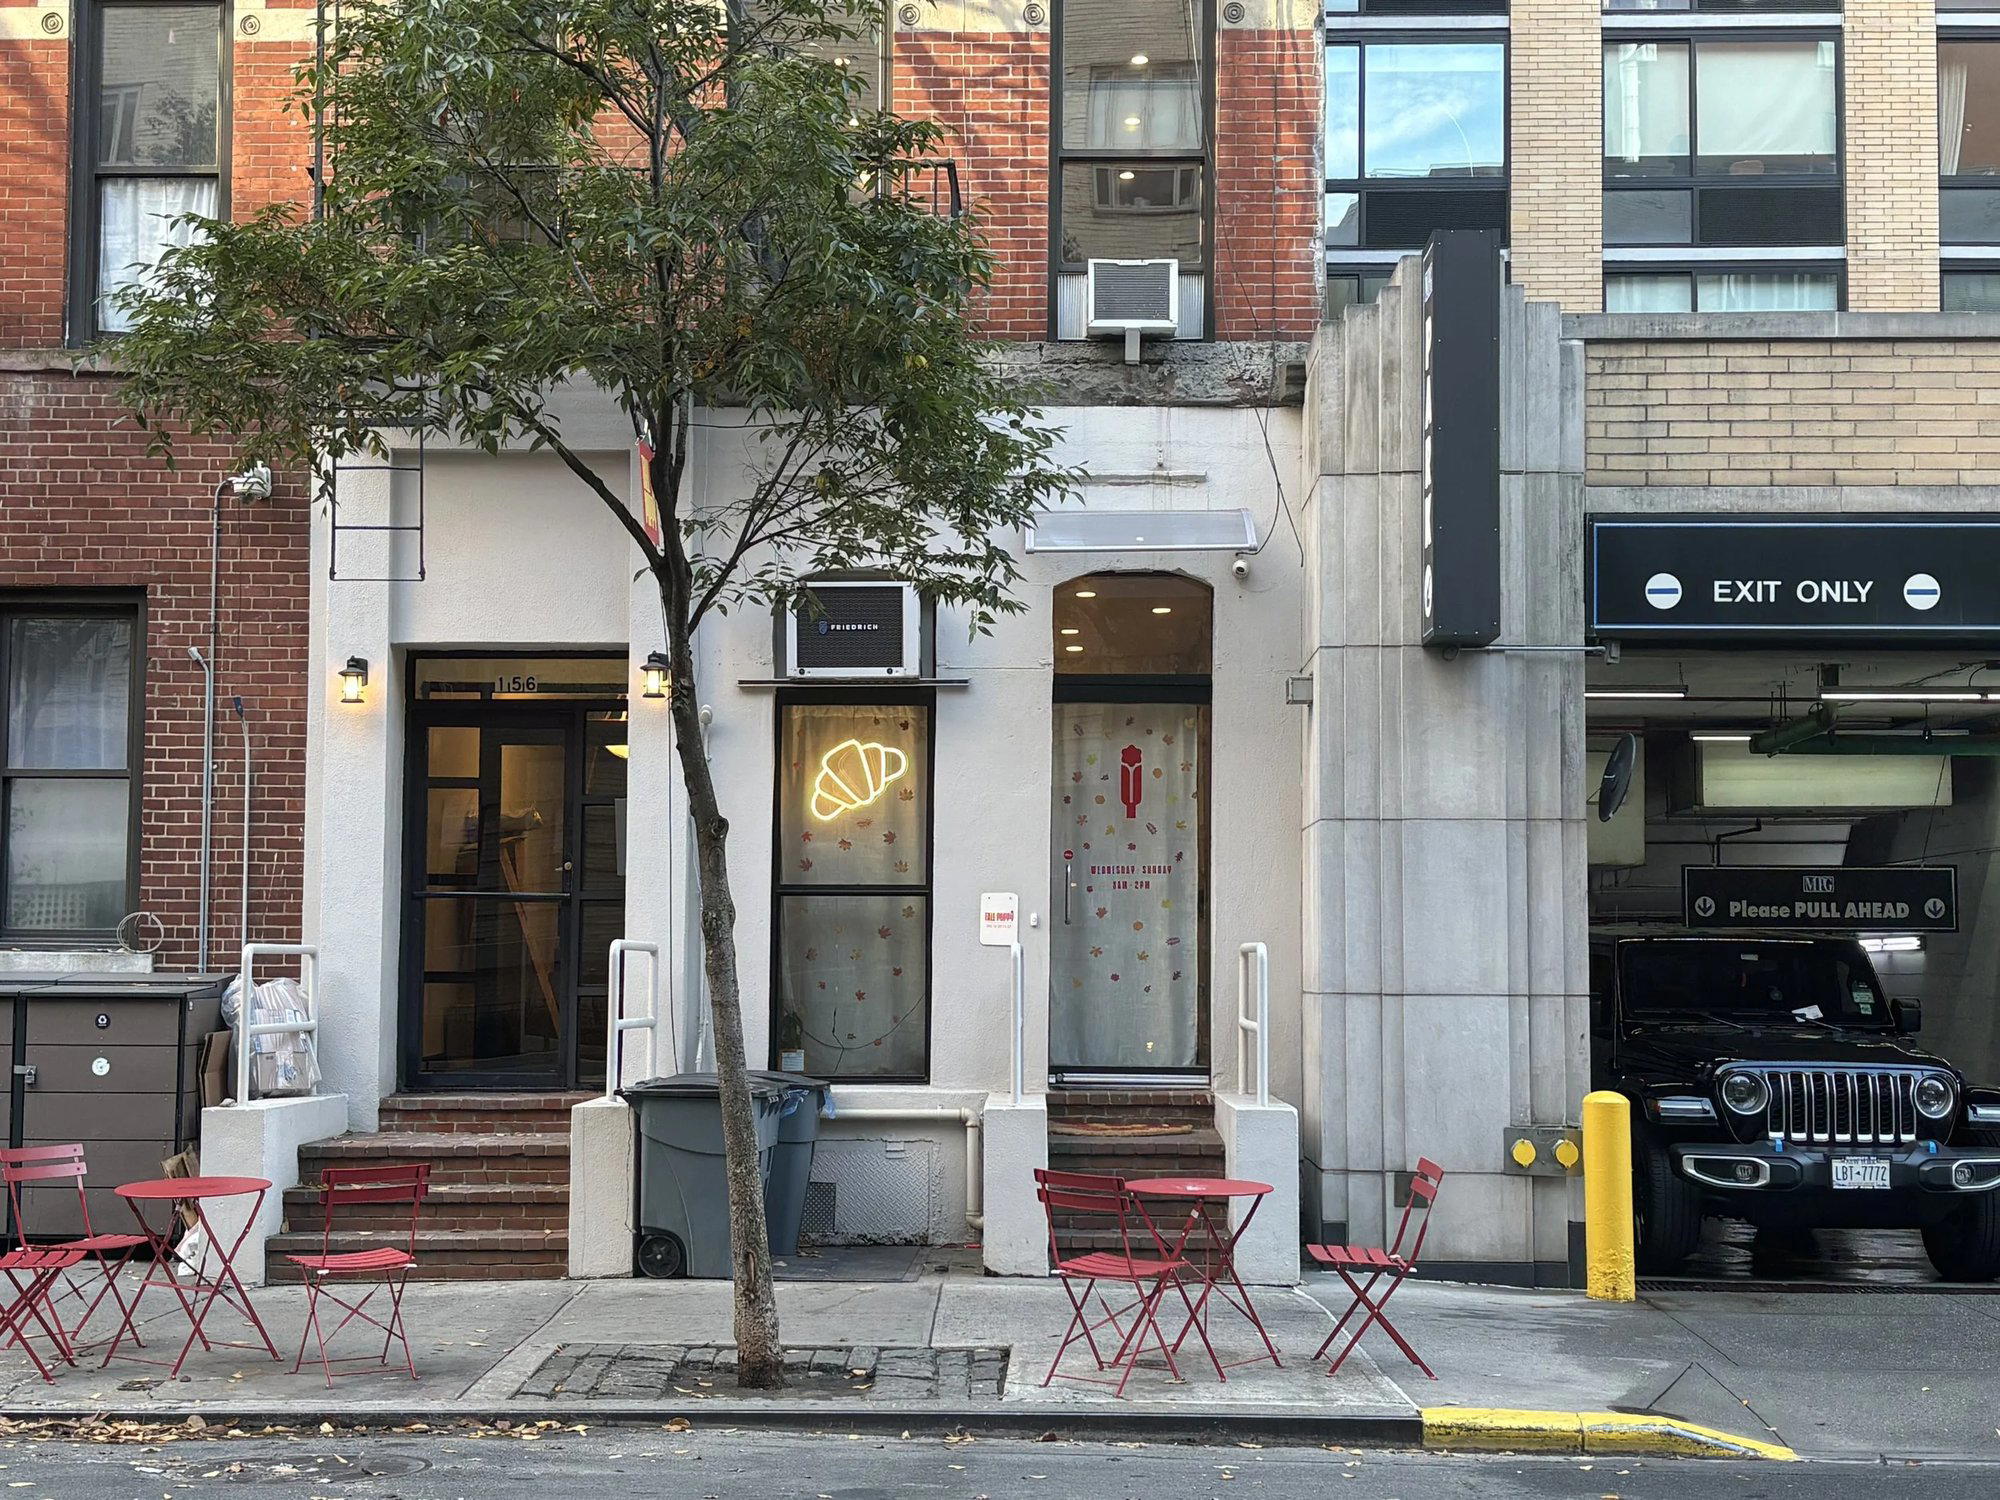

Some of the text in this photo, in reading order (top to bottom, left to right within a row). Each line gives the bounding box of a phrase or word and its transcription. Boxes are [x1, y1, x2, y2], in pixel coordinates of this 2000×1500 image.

[1713, 579, 1874, 603] EXIT ONLY
[498, 675, 537, 691] 156
[1090, 865, 1172, 875] WEDNESDAY SUNDAY
[1729, 899, 1910, 919] Please PULL AHEAD
